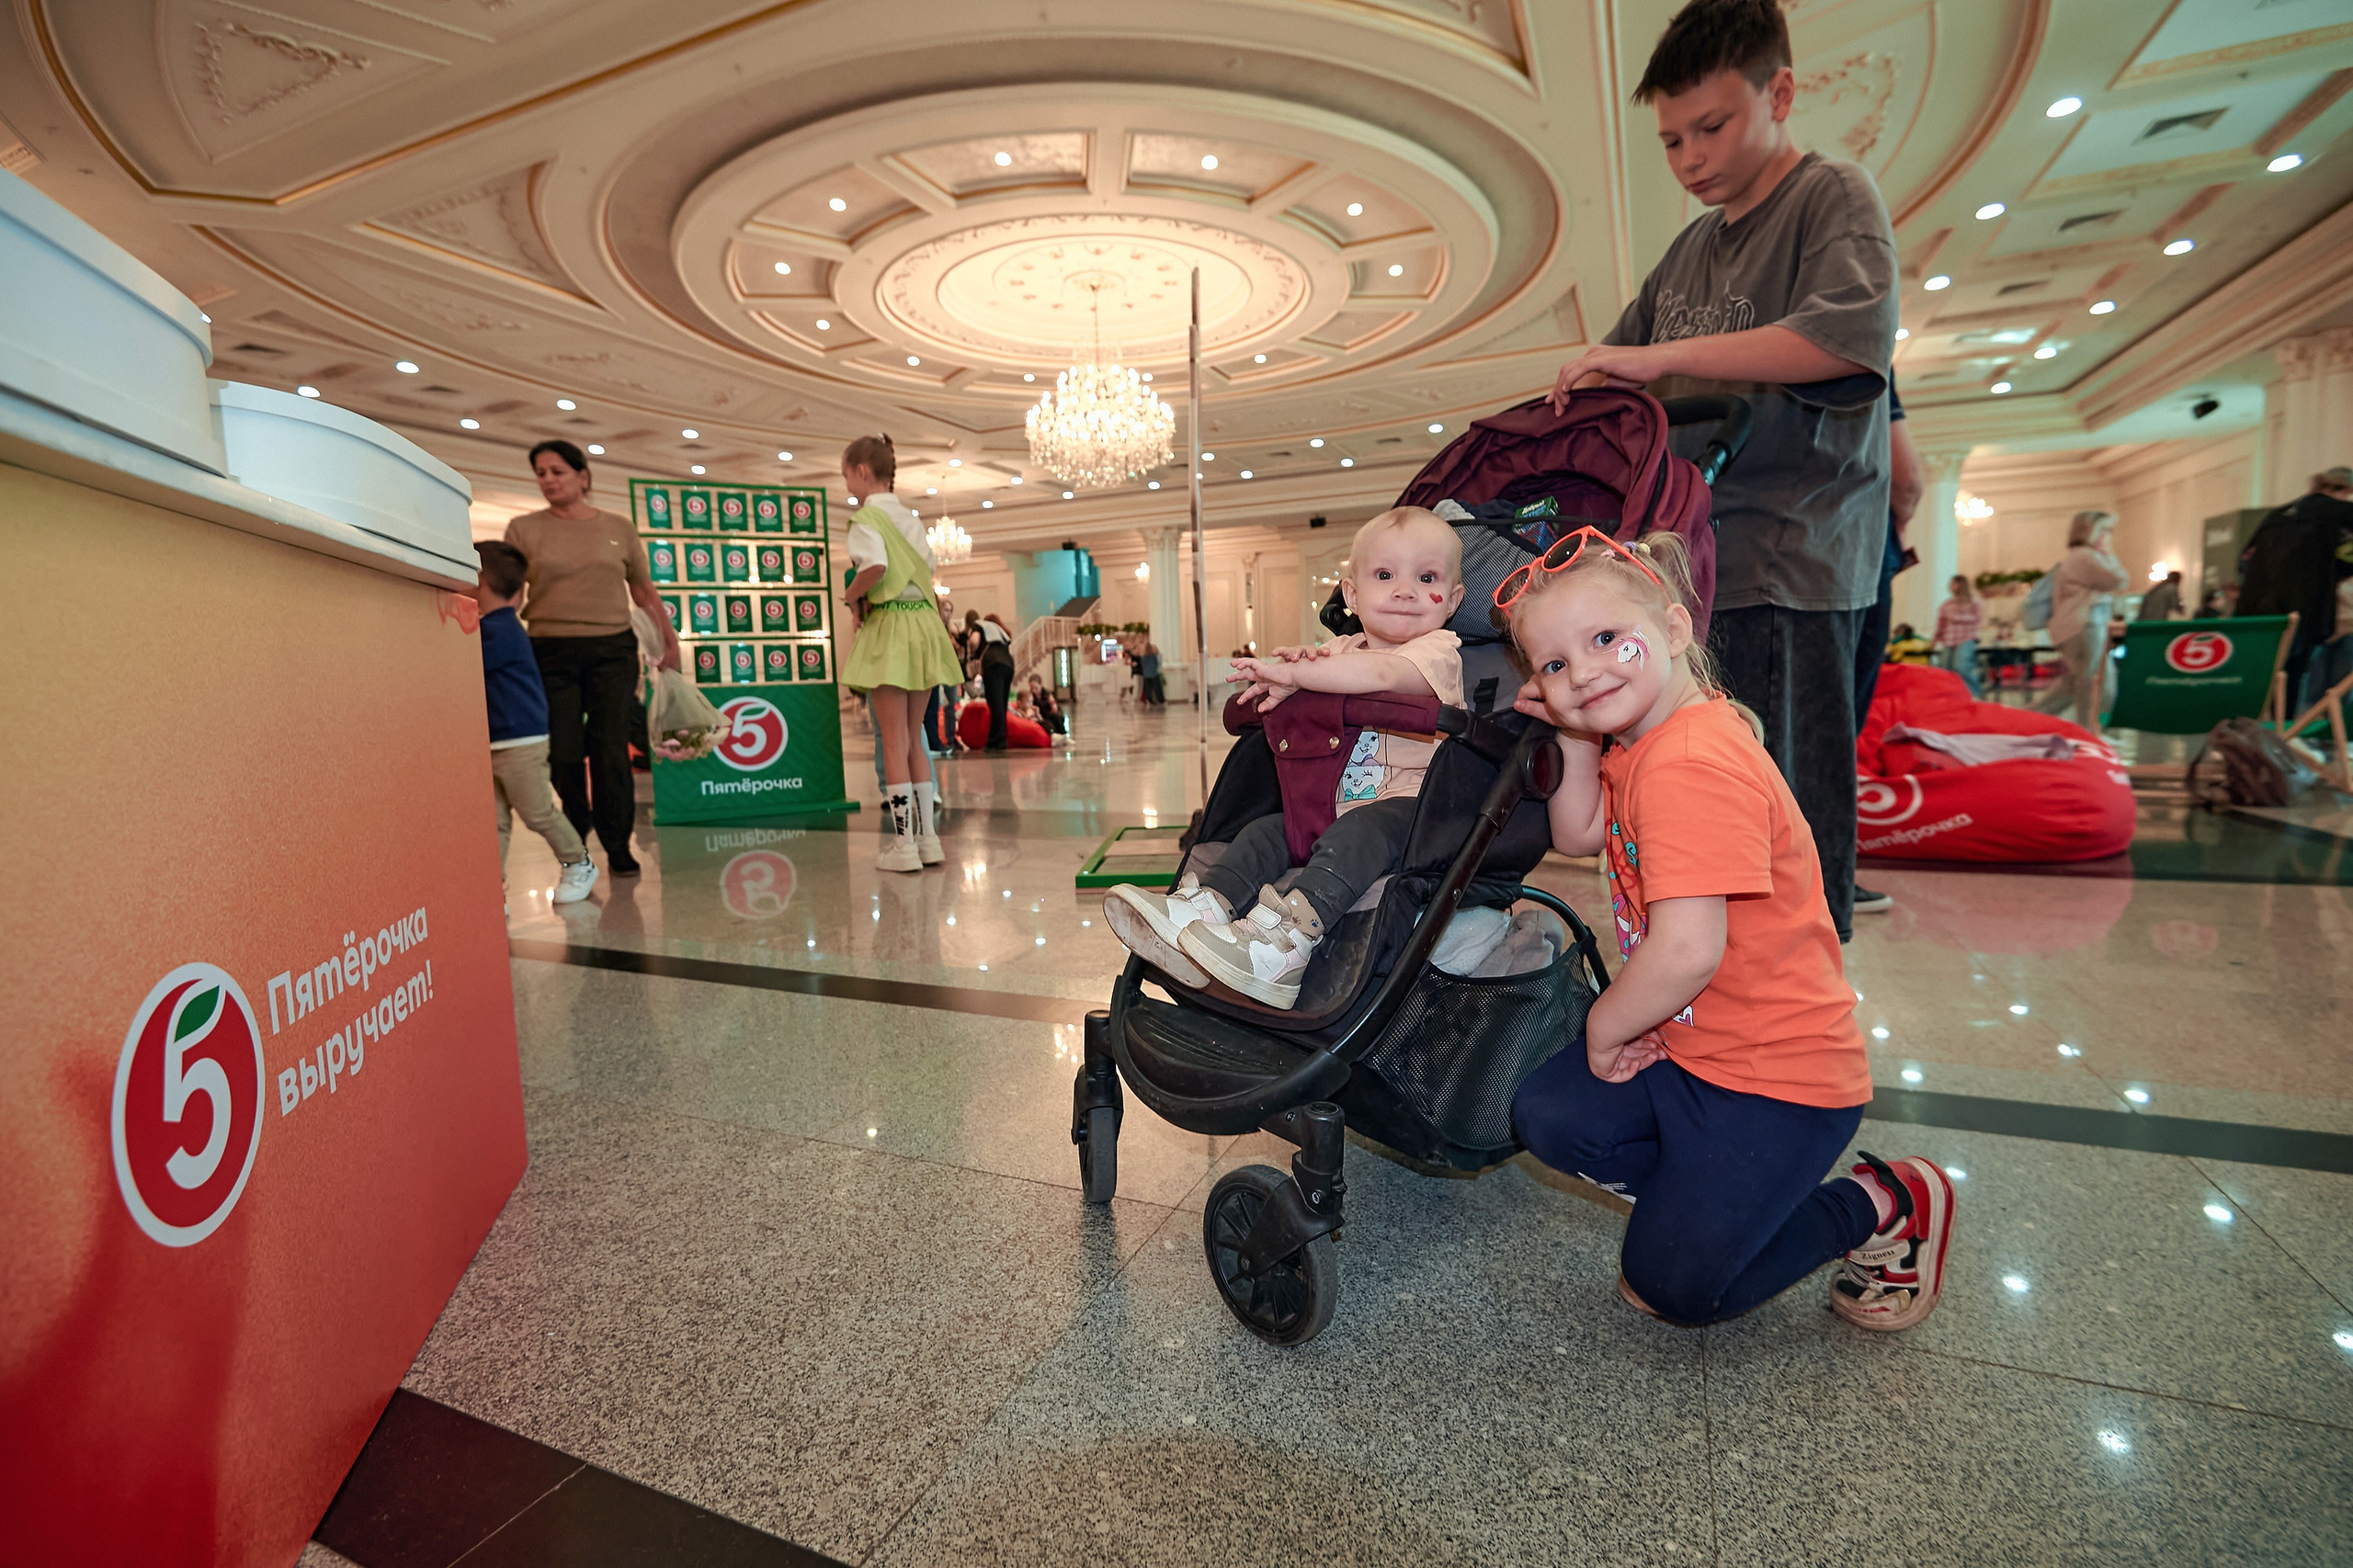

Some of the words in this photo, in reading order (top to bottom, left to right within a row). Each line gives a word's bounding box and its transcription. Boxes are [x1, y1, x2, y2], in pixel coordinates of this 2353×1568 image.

[701, 778, 802, 795] Пятёрочка
[267, 907, 428, 1035] Пятёрочка
[278, 960, 434, 1117] выручает!
